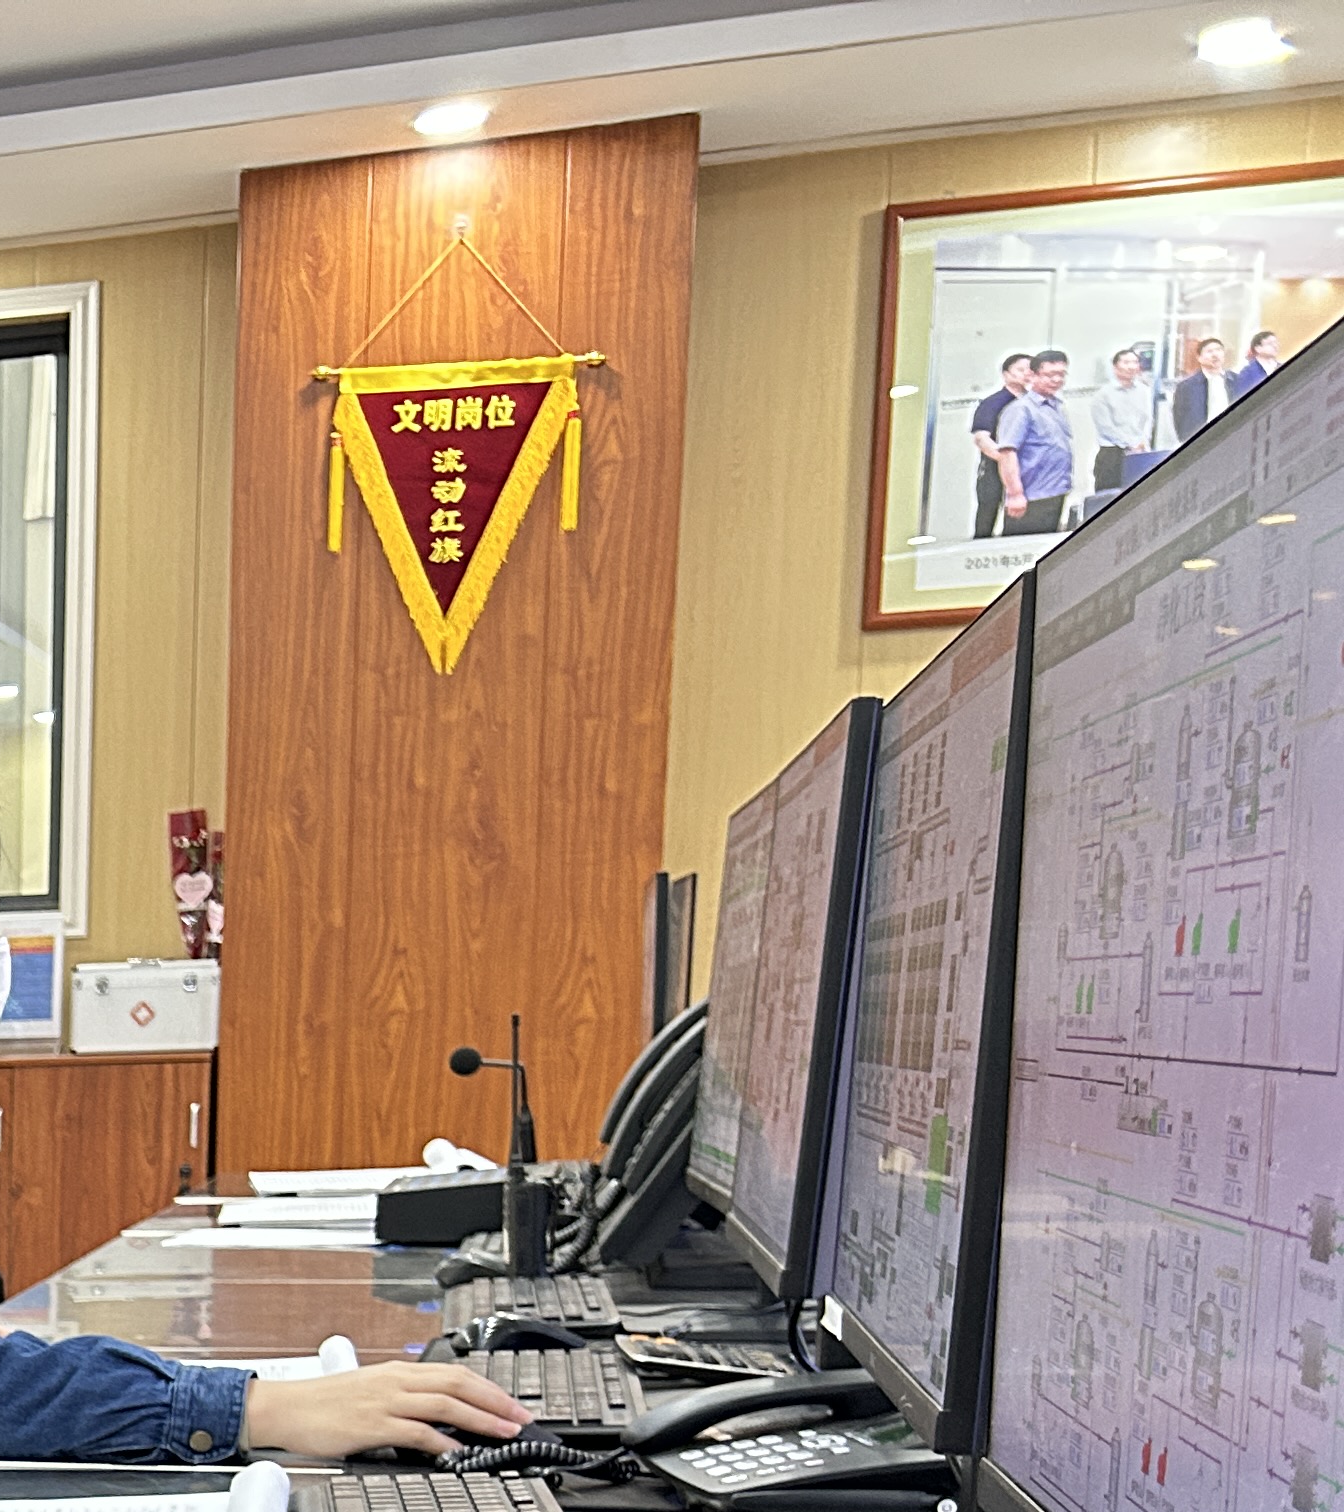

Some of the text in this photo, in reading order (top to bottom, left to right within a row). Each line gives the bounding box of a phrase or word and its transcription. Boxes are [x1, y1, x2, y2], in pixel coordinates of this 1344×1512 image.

[391, 394, 517, 433] 文明岗位
[428, 447, 468, 563] 流动红旗
